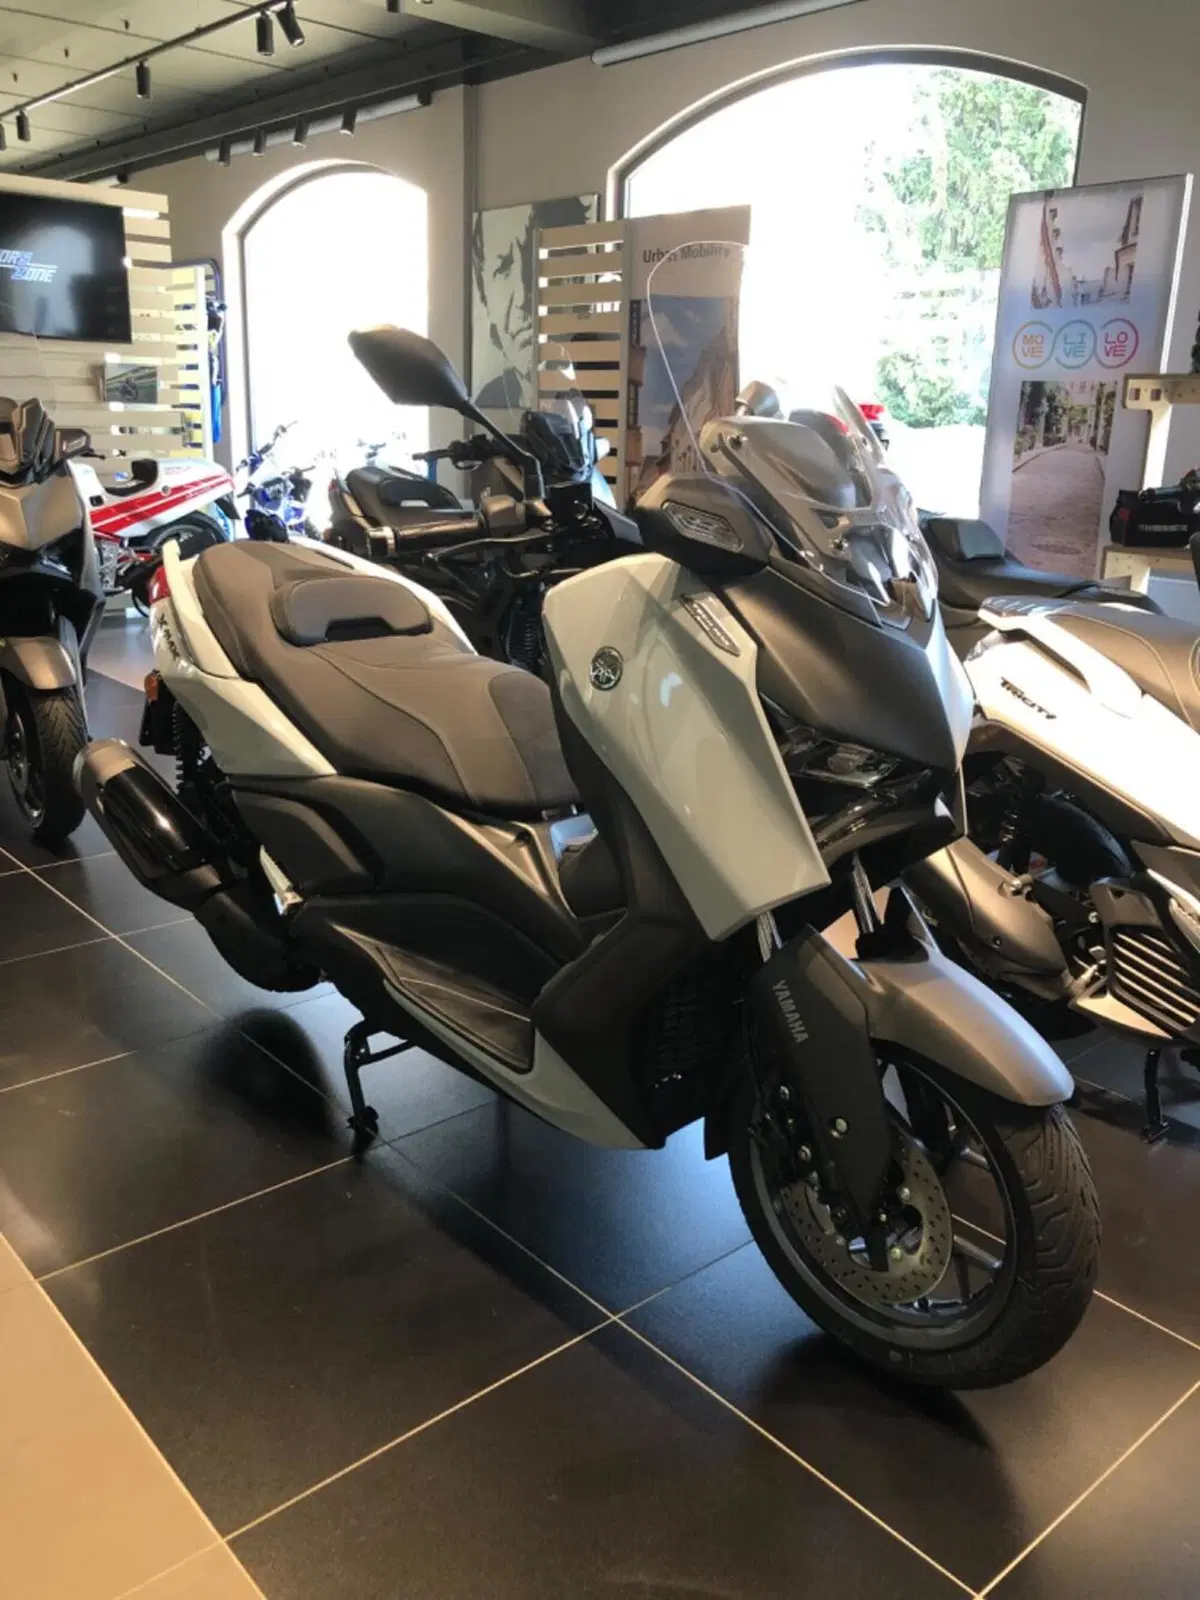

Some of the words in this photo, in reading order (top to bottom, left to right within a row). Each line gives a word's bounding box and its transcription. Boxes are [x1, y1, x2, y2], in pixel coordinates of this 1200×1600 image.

[643, 246, 677, 263] Urban
[680, 242, 731, 261] Mobility
[1000, 676, 1057, 720] TRICITY
[772, 979, 809, 1043] YAMAHA
